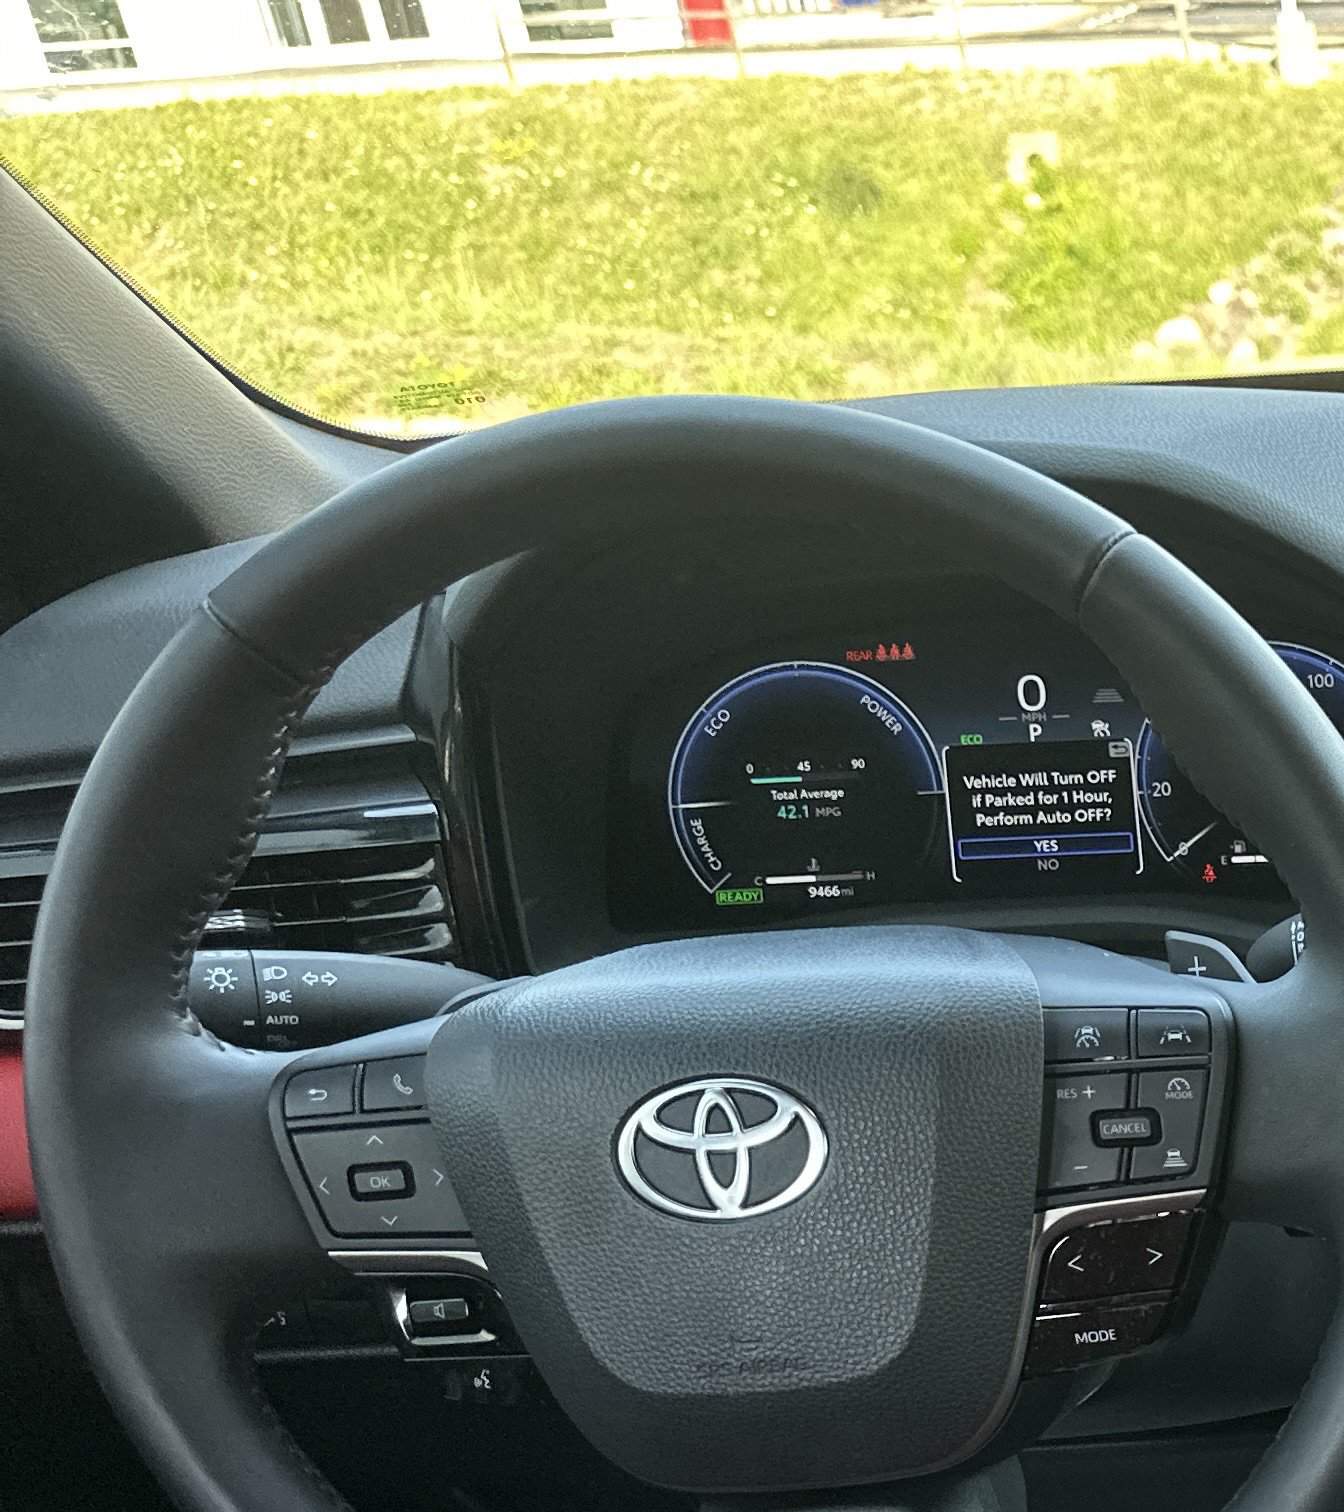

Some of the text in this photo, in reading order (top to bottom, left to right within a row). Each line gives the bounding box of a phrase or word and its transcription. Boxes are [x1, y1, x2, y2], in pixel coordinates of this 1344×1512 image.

[846, 650, 873, 662] REAR
[1307, 674, 1335, 689] 100
[1017, 674, 1047, 712] 0
[859, 694, 903, 736] POWER
[1021, 712, 1047, 722] MPH
[703, 708, 731, 737] ECO
[960, 734, 983, 746] ECO
[1028, 723, 1043, 743] P
[745, 763, 754, 774] 0
[797, 760, 811, 772] 45
[851, 758, 866, 770] 90
[963, 769, 1117, 790] Vehicle Will Turn OFF
[770, 788, 845, 802] Total Average
[1151, 782, 1172, 798] 20
[971, 789, 1113, 808] if Parked for 1 Hour,
[777, 804, 842, 819] 42.1 MPG
[975, 807, 1112, 827] Perform Auto OFF?
[690, 818, 723, 871] CHARGE
[1033, 839, 1060, 853] YES
[1037, 858, 1060, 871] NO
[1221, 855, 1228, 866] E
[754, 876, 764, 886] C
[866, 871, 876, 881] H
[718, 890, 761, 903] READY
[807, 886, 841, 898] 9466
[266, 1014, 300, 1026] AUTO
[1056, 1087, 1078, 1099] RES
[1165, 1090, 1194, 1100] MODE
[1102, 1121, 1148, 1135] CANCEL
[369, 1174, 391, 1190] OK
[1074, 1327, 1117, 1346] MODE
